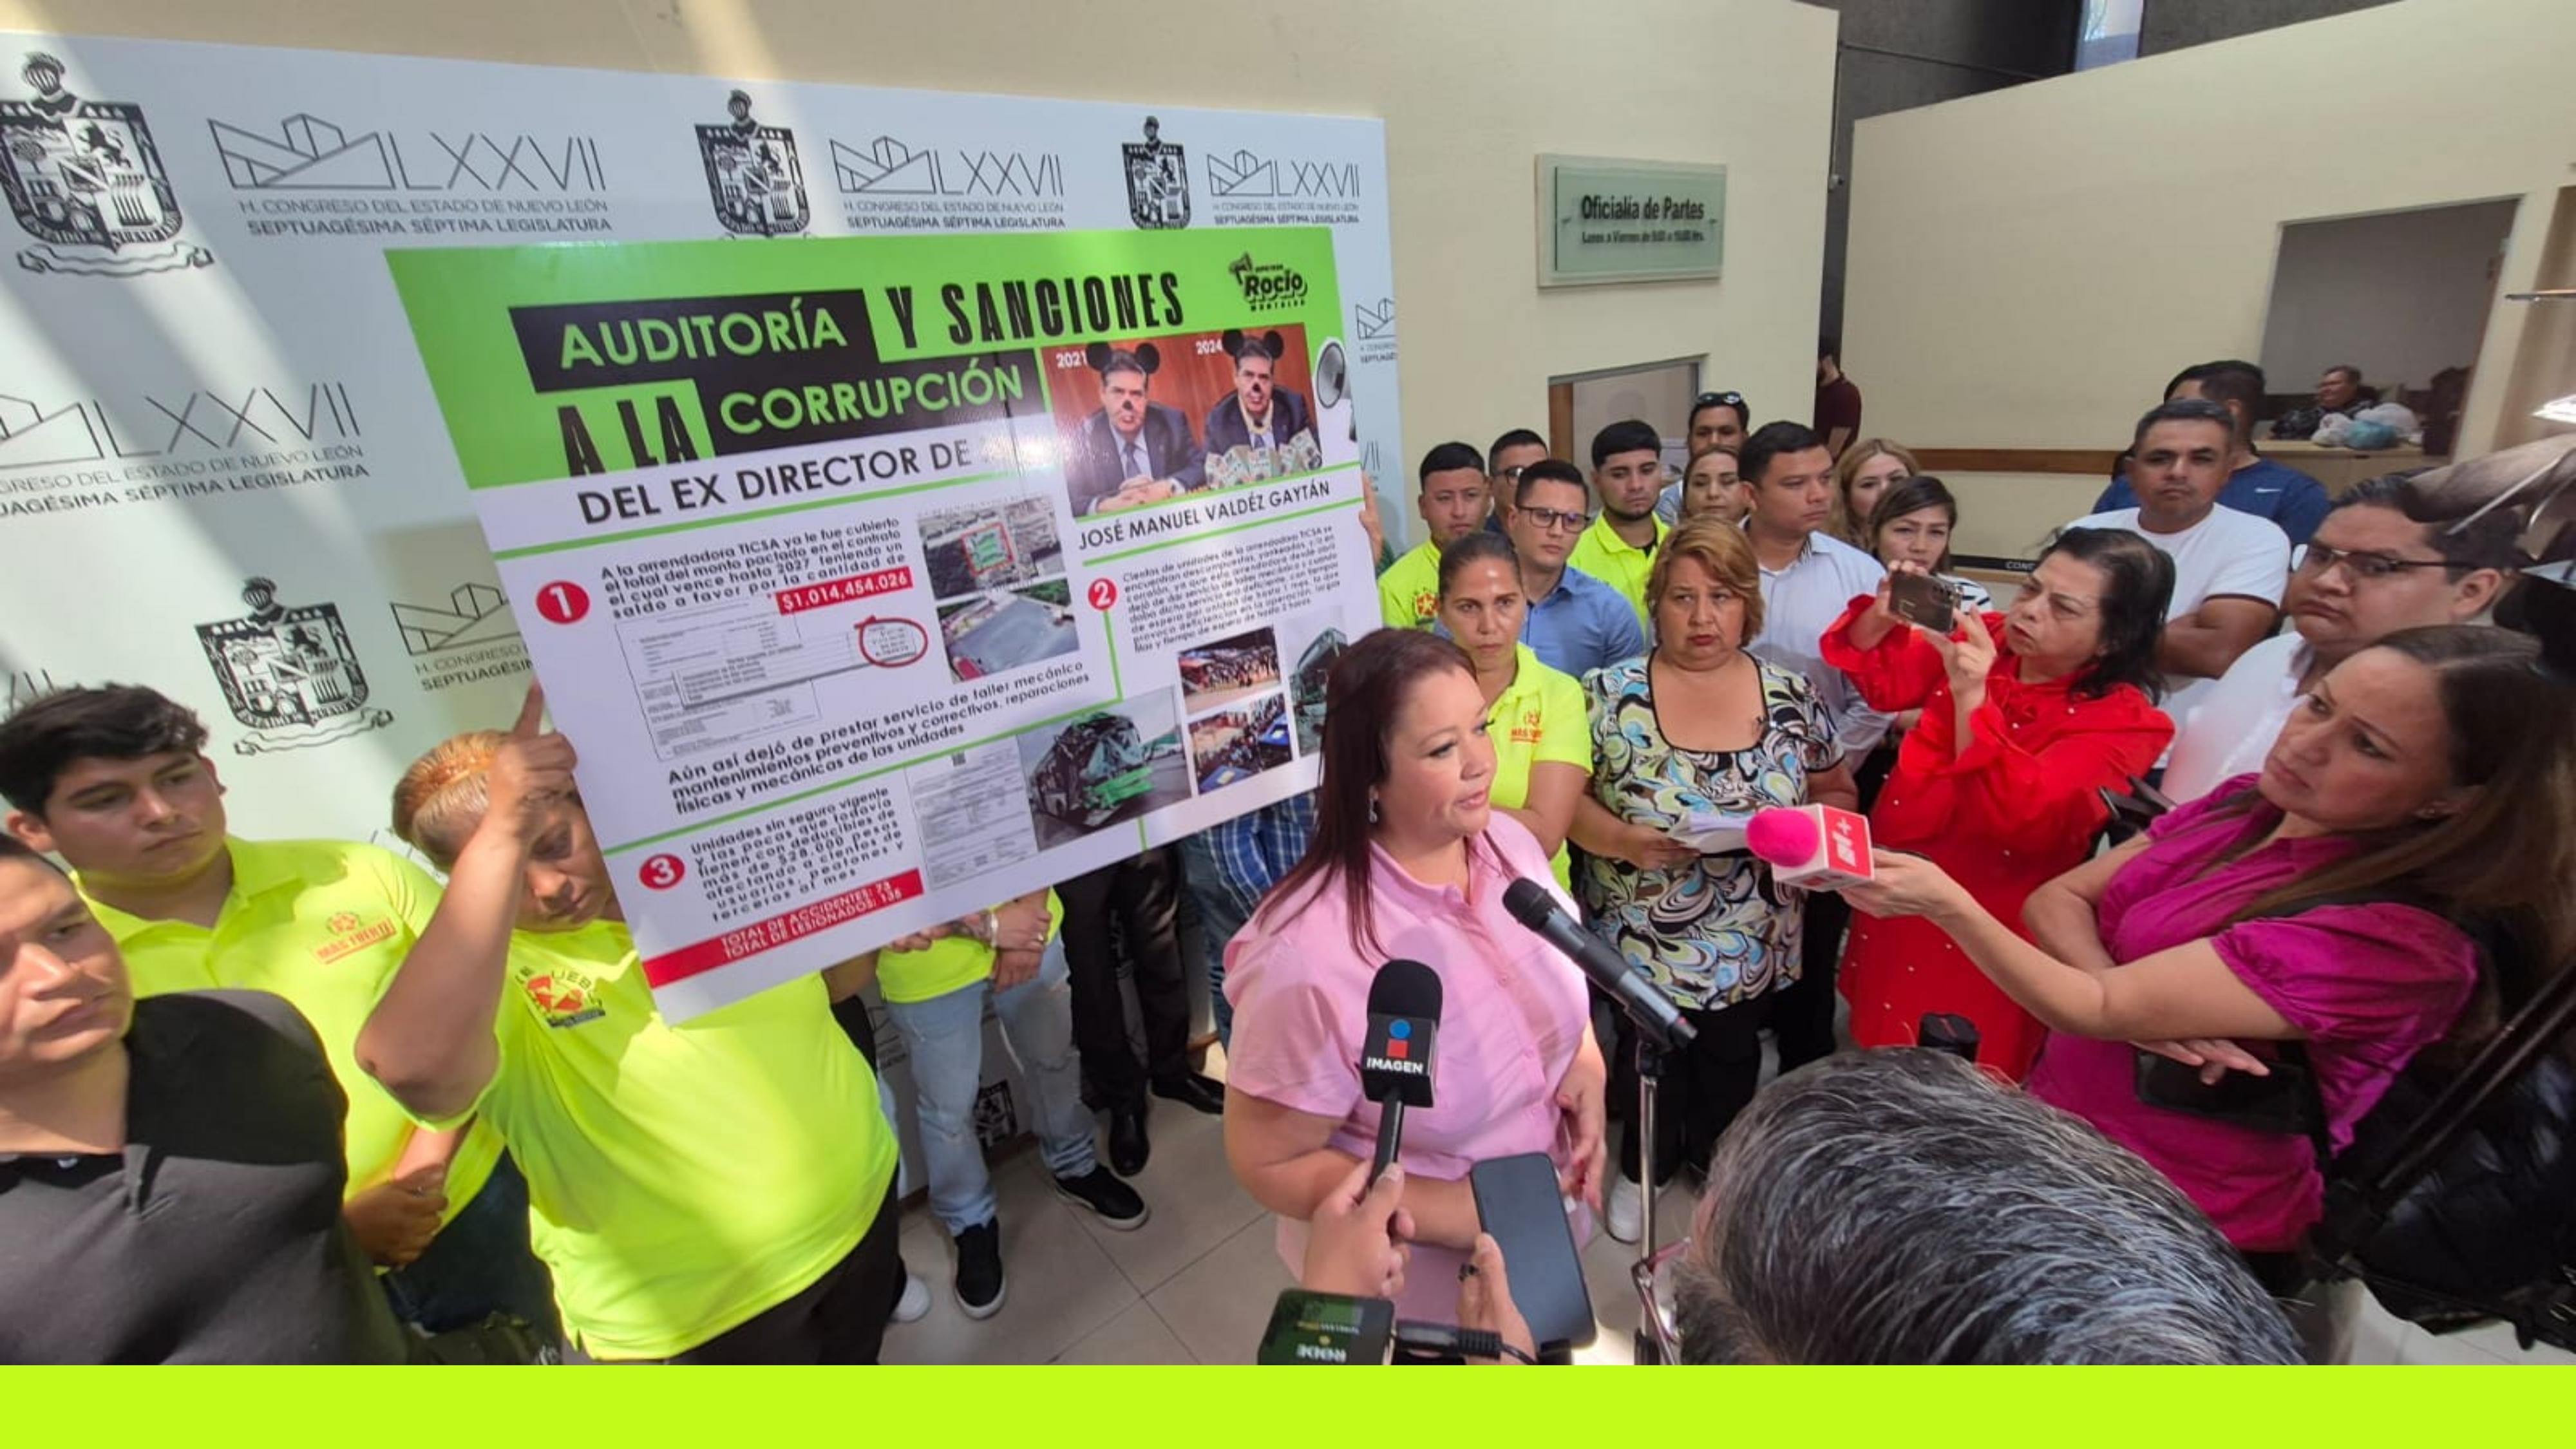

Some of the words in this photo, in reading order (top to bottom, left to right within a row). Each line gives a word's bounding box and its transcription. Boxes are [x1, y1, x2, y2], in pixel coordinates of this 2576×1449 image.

[248, 216, 406, 236] SEPTUAGÉSIMA
[413, 216, 493, 234] SÉPTIMA
[497, 218, 612, 232] LEGISLATURA
[261, 199, 368, 214] CONGRESO
[373, 200, 409, 214] DEL
[411, 200, 479, 214] ESTADO
[482, 200, 503, 213] DE
[506, 200, 564, 213] NUEVO
[566, 196, 607, 212] LEÓN
[847, 215, 939, 228] SEPTUAGÉSIMA
[943, 216, 991, 228] SÉPTIMA
[994, 217, 1065, 228] LEGISLATURA
[857, 201, 918, 212] CONGRESO
[922, 201, 942, 212] DEL
[944, 201, 984, 212] ESTADO
[987, 201, 999, 212] DE
[1002, 202, 1036, 213] NUEVO
[1643, 196, 1660, 220] de
[1663, 196, 1704, 220] Partes
[560, 297, 848, 369] AUDITORÍA
[885, 287, 918, 349] Y
[942, 272, 1184, 346] SANCIONES
[1056, 351, 1087, 368] 2021
[1196, 339, 1223, 354] 2024
[556, 404, 606, 478] A
[616, 395, 699, 470] LA
[719, 358, 1024, 435] CORRUPCIÓN
[77, 469, 122, 486] DEL
[128, 461, 205, 481] ESTADO
[210, 457, 232, 473] DE
[242, 451, 310, 468] NUEVO
[312, 444, 363, 461] LEÓN
[126, 478, 225, 502] SÉPTIMA
[229, 464, 370, 492] LEGISLATURA
[577, 479, 661, 526] DEL
[673, 474, 724, 511] EX
[735, 446, 920, 502] DIRECTOR
[929, 439, 972, 470] DE
[1079, 520, 1124, 550] JOSÉ
[1129, 507, 1202, 541] MANUEL
[1206, 493, 1265, 520] VALDÉZ
[1269, 480, 1331, 507] GAYTÁN
[602, 567, 614, 580] A
[616, 565, 633, 576] la
[638, 549, 735, 573] arrendadora
[738, 538, 780, 554] TICSA
[783, 536, 802, 549] ya
[804, 533, 817, 543] le
[820, 529, 842, 540] fue
[846, 518, 899, 535] cubierto
[605, 579, 620, 592] el
[623, 572, 660, 589] total
[665, 567, 689, 582] del
[694, 560, 741, 576] monto
[745, 547, 808, 569] pactado
[811, 544, 828, 554] en
[831, 539, 844, 551] el
[847, 529, 900, 548] contrato
[609, 592, 625, 605] el
[630, 584, 668, 602] cual
[673, 577, 724, 593] vence
[729, 567, 772, 583] hasta
[777, 558, 809, 574] 2027
[819, 546, 881, 565] teniendo
[886, 543, 902, 553] un
[613, 600, 667, 619] saldo
[675, 598, 686, 607] a
[693, 587, 739, 603] favor
[748, 580, 776, 596] por
[784, 574, 799, 585] la
[807, 556, 880, 581] cantidad
[887, 554, 905, 565] de
[1095, 581, 1111, 606] 2
[1123, 568, 1159, 582] Cientos
[1162, 564, 1174, 573] de
[549, 586, 573, 619] 1
[433, 644, 521, 670] CONGRESO
[669, 766, 706, 784] Aún
[712, 753, 739, 772] así
[744, 741, 788, 764] dejó
[792, 736, 813, 750] de
[820, 719, 876, 746] prestar
[884, 701, 944, 725] servicio
[949, 694, 968, 706] de
[973, 683, 1009, 700] taller
[1014, 662, 1083, 689] mecánico
[672, 753, 811, 801] mantenimientos
[815, 727, 905, 762] preventivos
[908, 723, 917, 735] y
[1006, 674, 1089, 705] reparaciones
[735, 786, 746, 800] y
[751, 759, 844, 793] mecánicas
[848, 752, 867, 764] de
[872, 744, 893, 758] las
[898, 724, 963, 750] unidades
[691, 828, 762, 855] Unidades
[766, 820, 785, 832] sin
[789, 805, 835, 825] seguro
[839, 788, 888, 809] vigente
[696, 857, 706, 868] y
[710, 848, 735, 862] las
[742, 830, 792, 854] pocas
[799, 819, 828, 835] que
[698, 852, 750, 878] tienen
[756, 845, 785, 860] con
[791, 817, 872, 849] deducibles
[878, 810, 895, 821] de
[748, 862, 770, 875] de
[852, 820, 898, 845] pesos
[810, 847, 887, 881] peatones
[896, 841, 903, 850] y
[650, 857, 676, 885] 3
[706, 865, 796, 900] afectando
[803, 860, 812, 869] a
[820, 838, 876, 863] cientos
[884, 831, 901, 842] de
[712, 891, 790, 922] terceros
[800, 880, 815, 893] al
[824, 869, 855, 886] mes
[721, 926, 764, 949] TOTAL
[768, 918, 785, 932] DE
[725, 934, 768, 958] TOTAL
[770, 927, 788, 943] DE
[1366, 1056, 1423, 1074] IMAGEN
